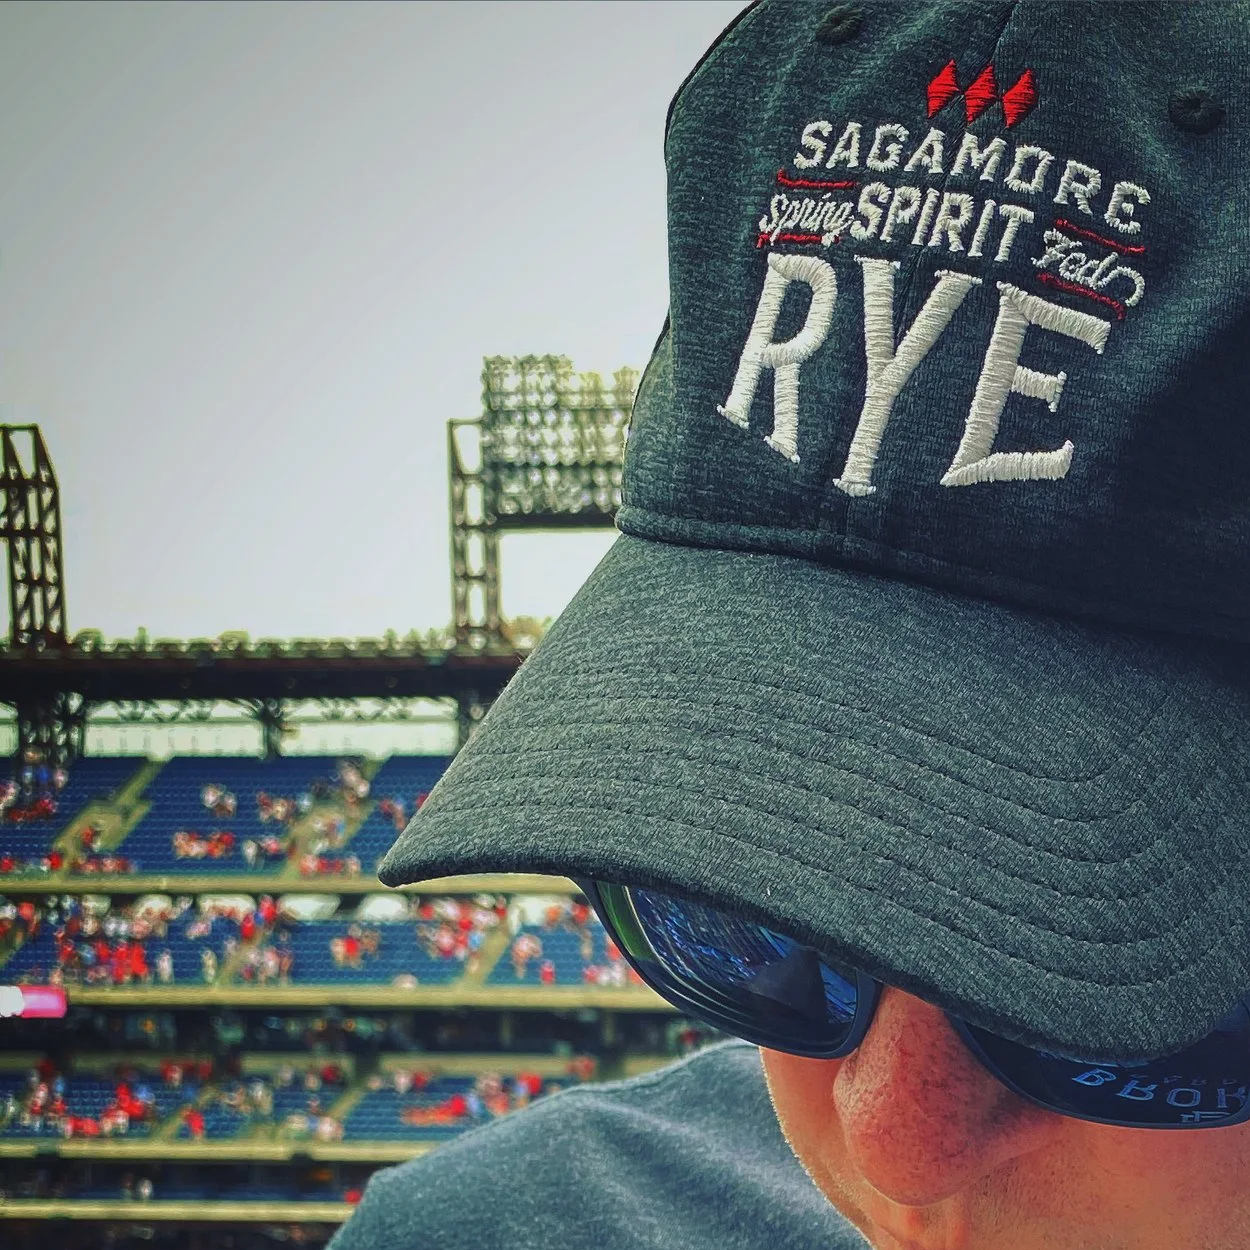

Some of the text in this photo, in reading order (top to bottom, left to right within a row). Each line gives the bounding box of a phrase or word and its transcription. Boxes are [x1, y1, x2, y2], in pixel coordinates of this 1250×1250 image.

[758, 193, 855, 249] Spring
[793, 119, 1152, 235] SAGAMORE
[849, 180, 1036, 263] SPIRIT
[716, 251, 1113, 498] RYE
